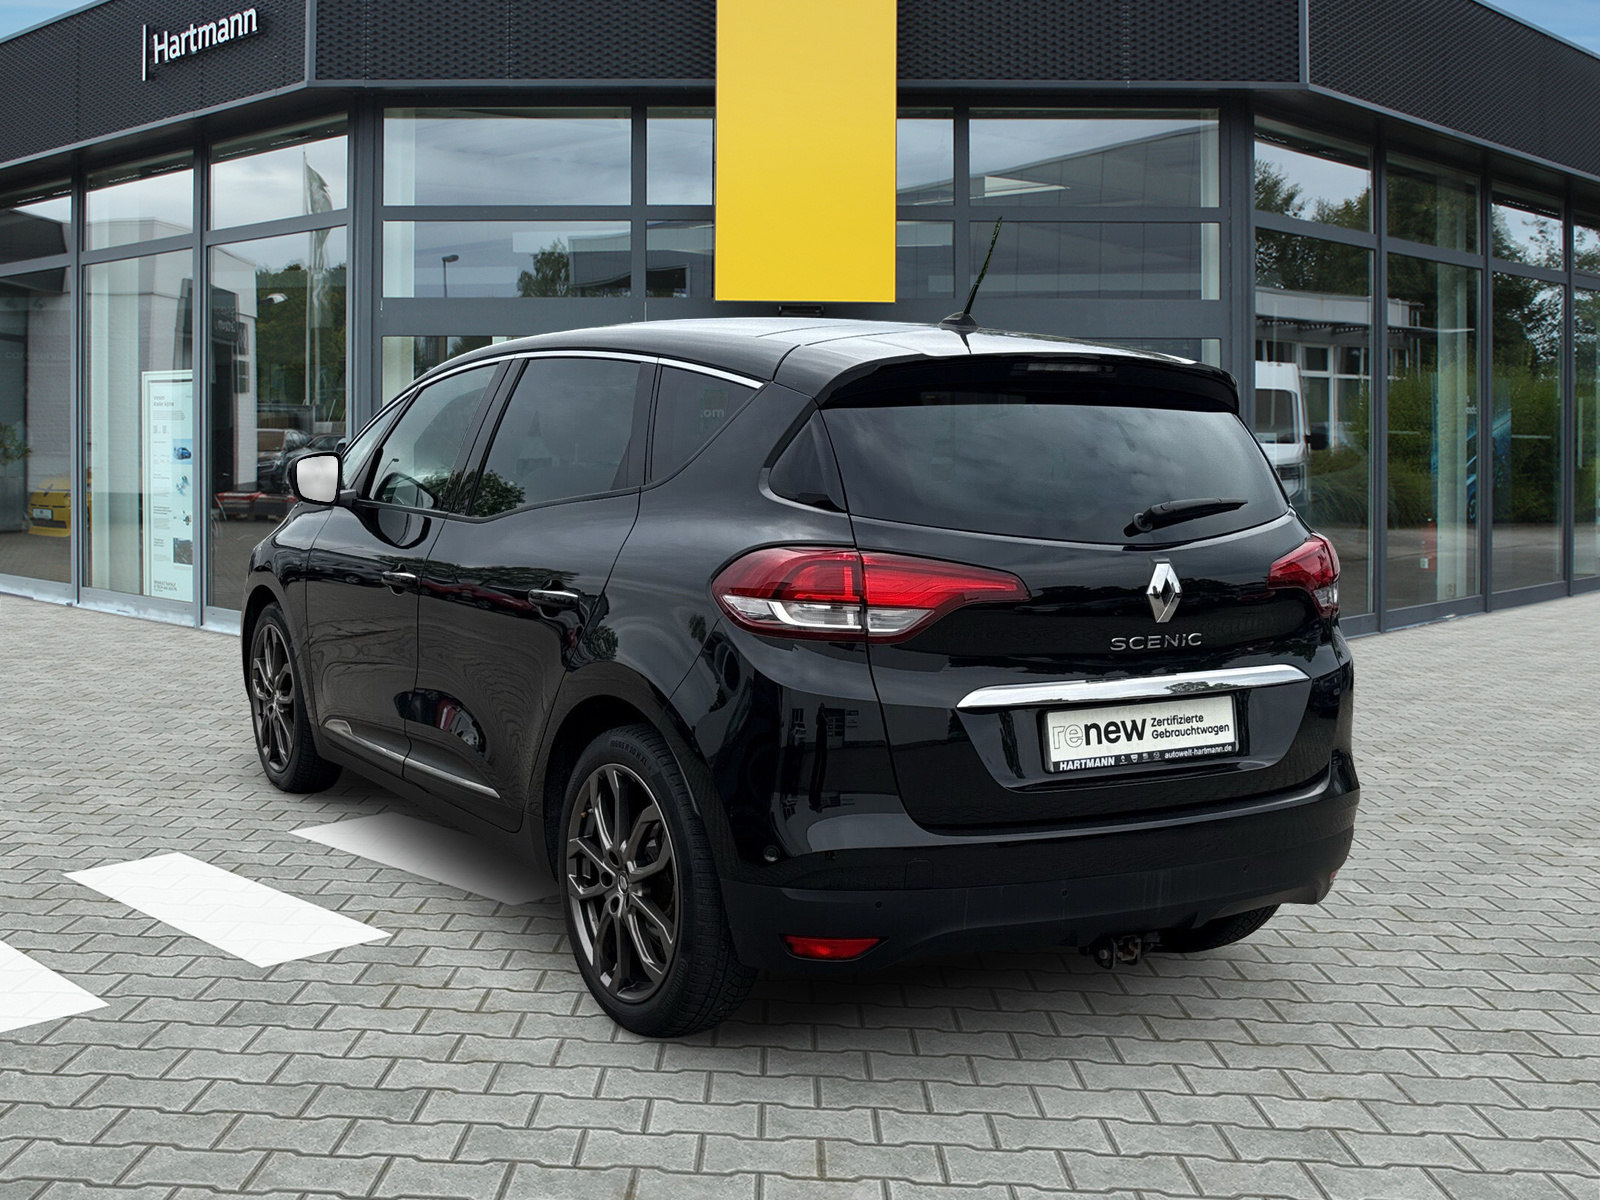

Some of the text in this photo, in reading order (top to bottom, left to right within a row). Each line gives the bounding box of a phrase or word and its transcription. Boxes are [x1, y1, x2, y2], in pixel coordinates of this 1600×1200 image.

[152, 7, 258, 64] Hartmann
[1110, 632, 1202, 651] SCENIC
[1150, 713, 1205, 728] Zertifizierte
[1052, 718, 1147, 750] renew
[1151, 722, 1230, 740] Gebrauchtwagen
[1164, 744, 1232, 759] autowelt-hartmann.de
[1059, 756, 1116, 771] HARTMANN
